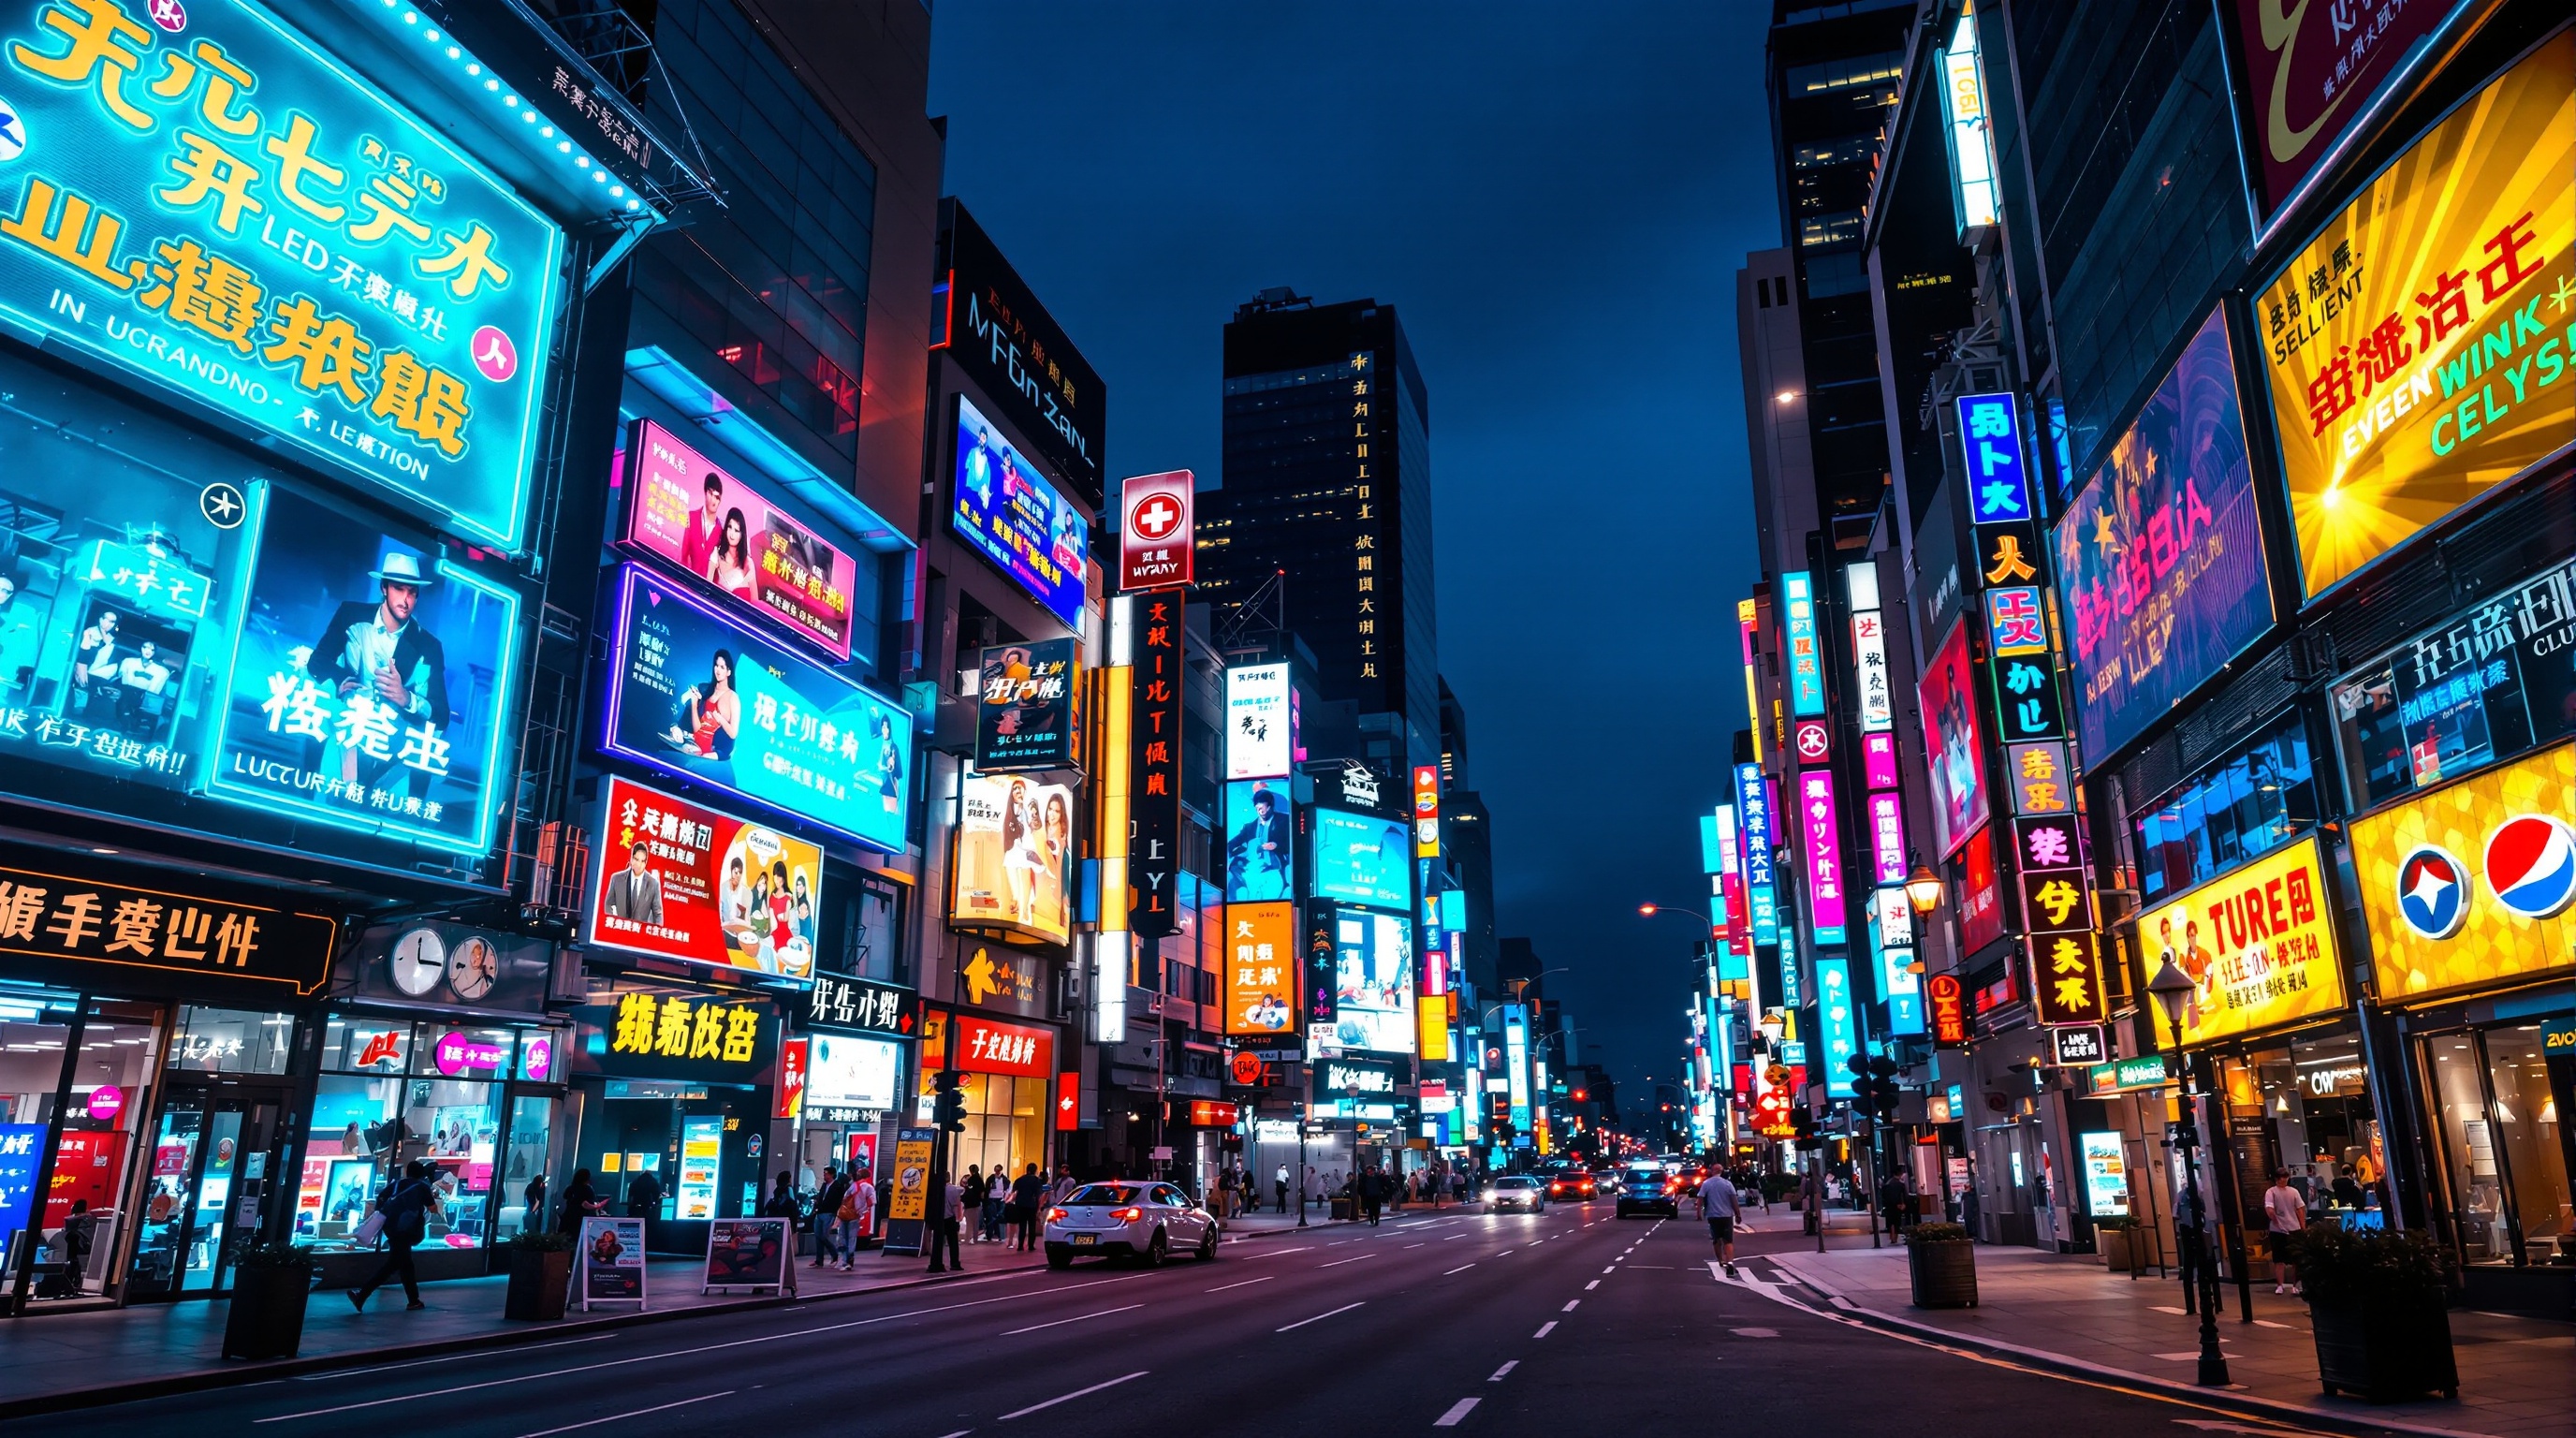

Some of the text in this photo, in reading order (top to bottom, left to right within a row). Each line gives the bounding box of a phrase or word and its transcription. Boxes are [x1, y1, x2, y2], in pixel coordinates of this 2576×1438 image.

[261, 213, 329, 271] LED
[50, 288, 86, 325] IN
[2275, 266, 2364, 366] SELLIENT
[2342, 294, 2547, 460] EVEEN WINK
